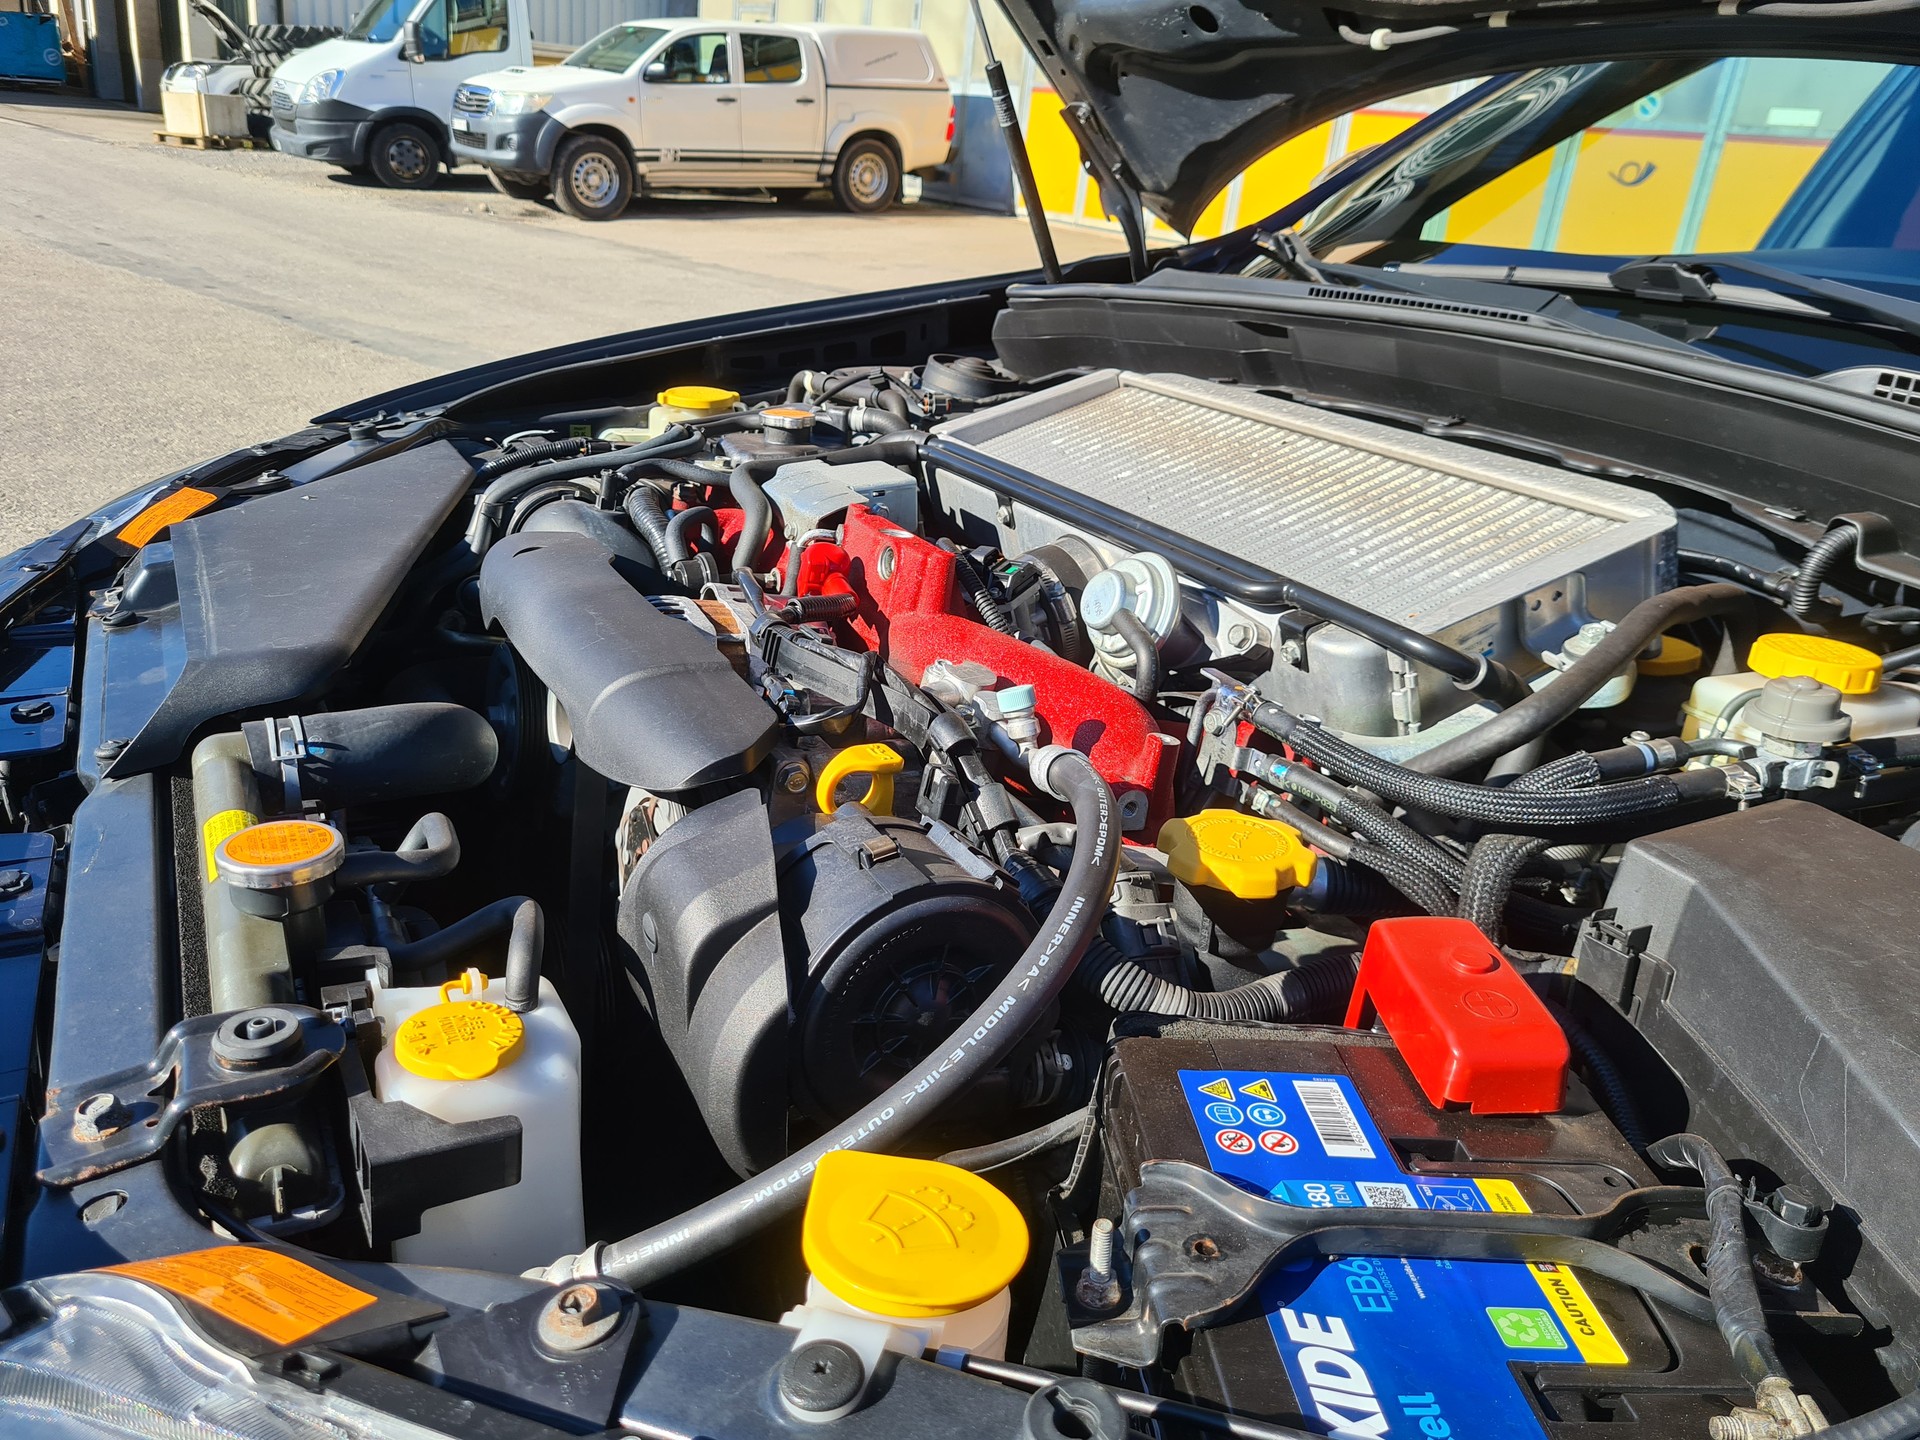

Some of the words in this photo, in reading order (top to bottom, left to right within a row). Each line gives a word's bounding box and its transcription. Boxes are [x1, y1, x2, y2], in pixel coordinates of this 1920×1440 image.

[1017, 895, 1086, 992] INNER>PA<
[468, 1001, 523, 1052] COOLANT
[901, 995, 1017, 1105] MIDDLE>IIR<
[1329, 1183, 1353, 1204] (EN)
[1337, 1256, 1394, 1313] EB6
[1547, 1278, 1596, 1337] CAUTION
[1534, 1317, 1552, 1340] RECYCLE
[1538, 1310, 1565, 1346] RESPONSIBLY
[1397, 1391, 1454, 1440] ell
